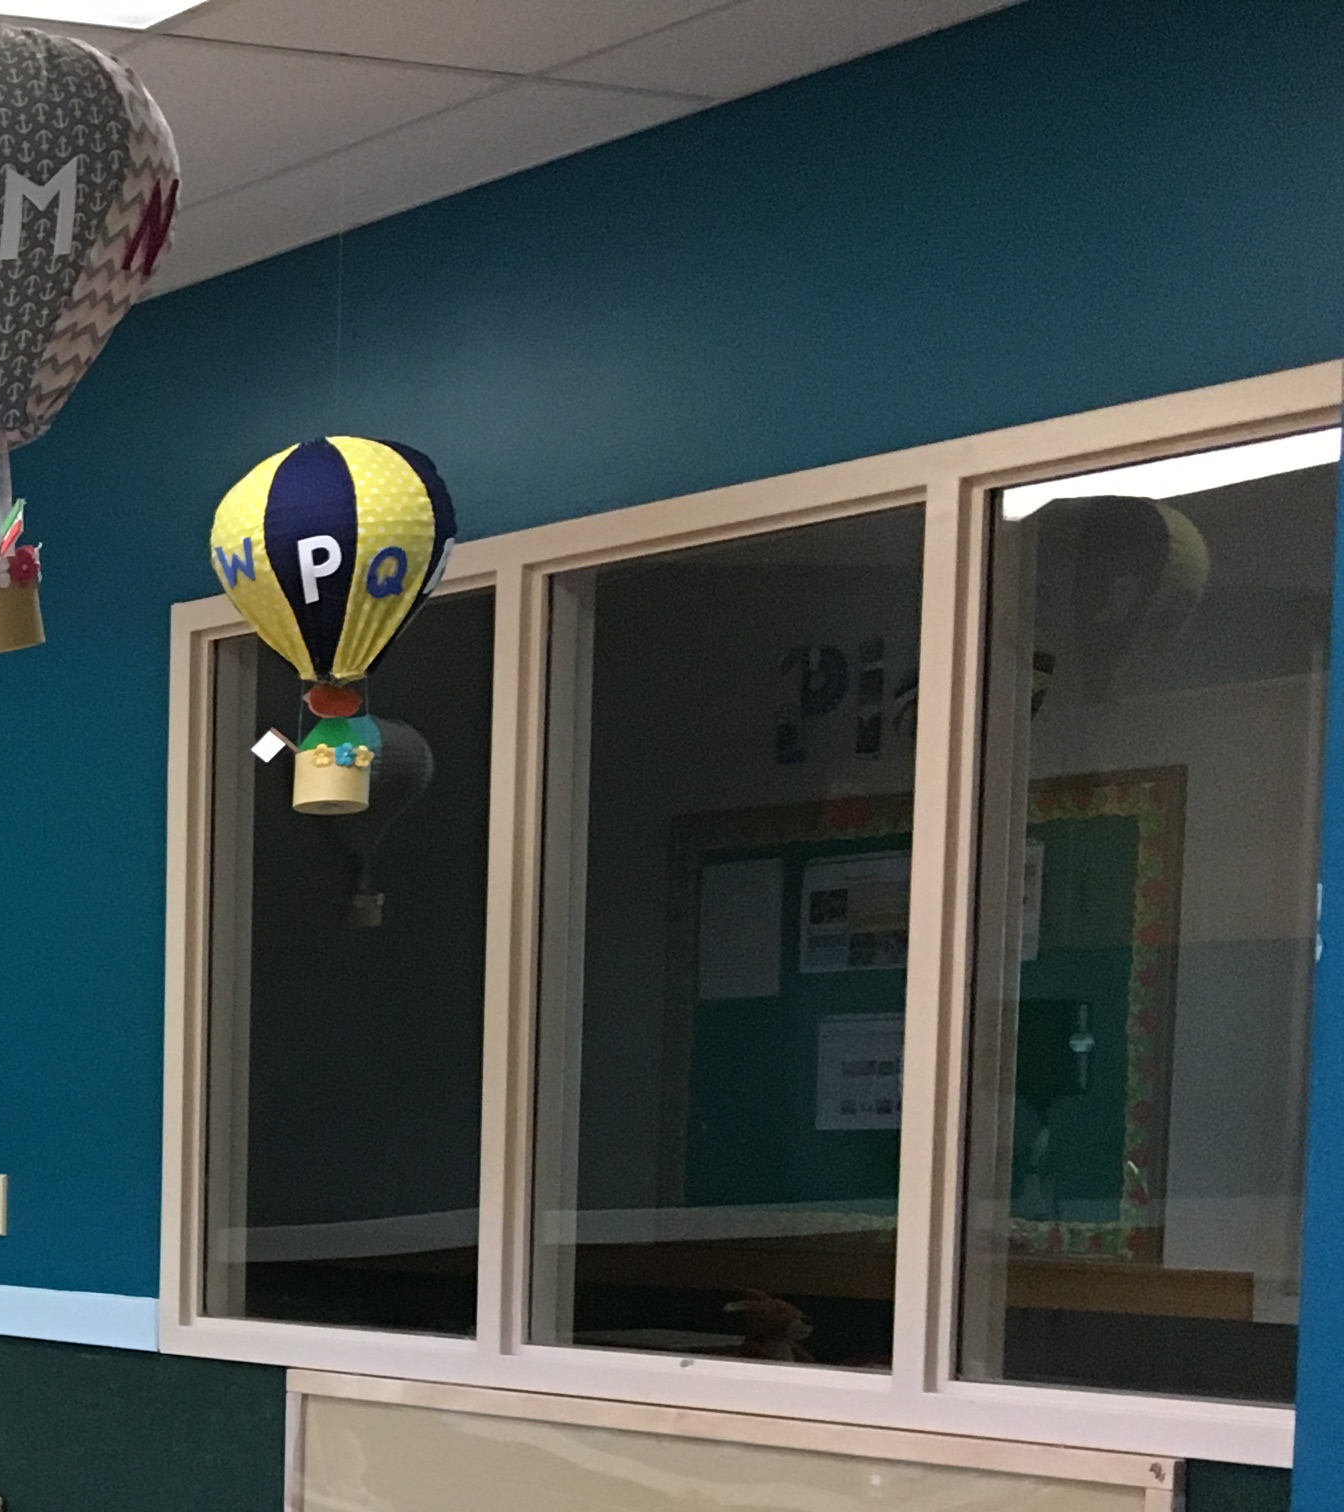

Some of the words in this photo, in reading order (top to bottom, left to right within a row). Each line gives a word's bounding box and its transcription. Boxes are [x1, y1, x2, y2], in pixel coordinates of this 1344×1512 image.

[0, 158, 78, 260] M
[121, 179, 180, 276] N
[215, 537, 256, 589] W
[297, 535, 342, 604] P
[365, 546, 408, 599] Q
